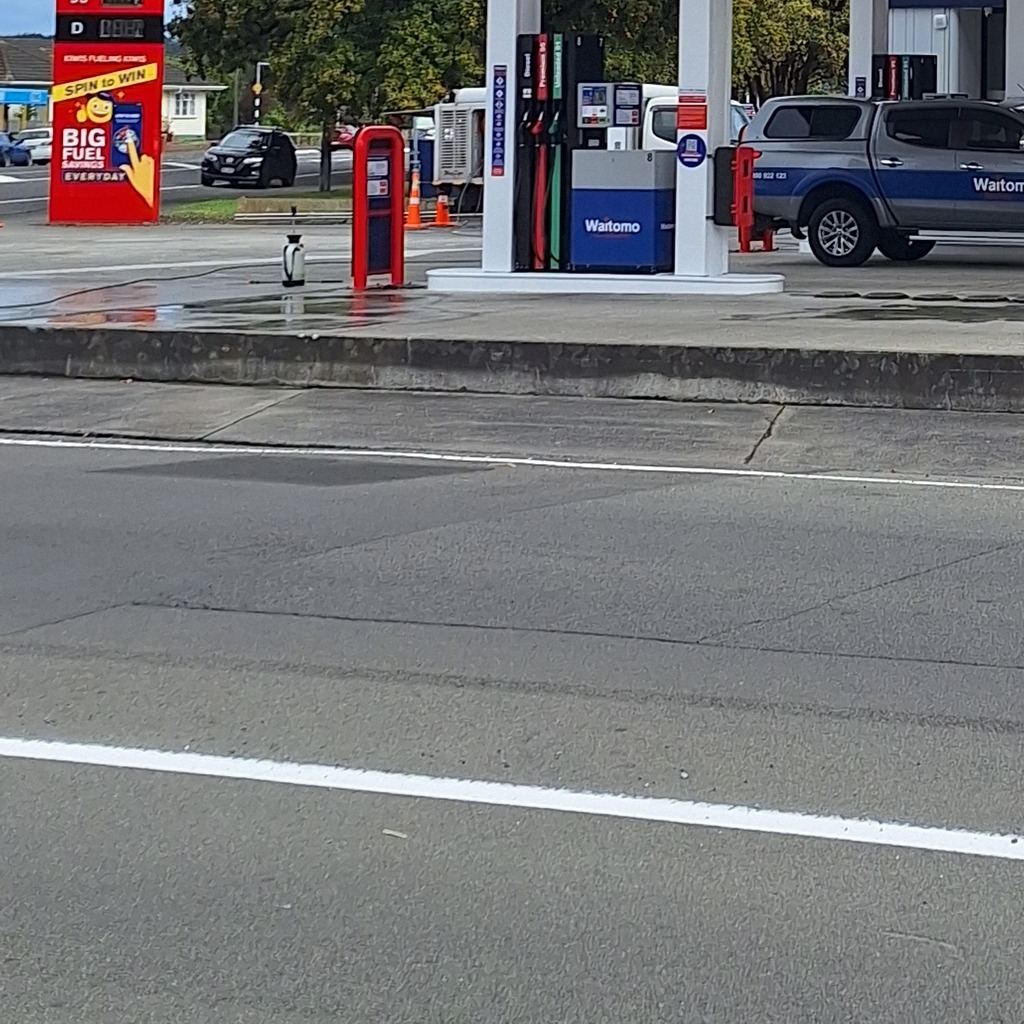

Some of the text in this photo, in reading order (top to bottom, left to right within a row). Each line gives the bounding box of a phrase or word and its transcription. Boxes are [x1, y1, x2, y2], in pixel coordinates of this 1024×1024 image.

[70, 21, 84, 35] D
[65, 69, 146, 97] SPIN to WIN
[62, 128, 106, 147] BIG
[62, 147, 105, 160] FUEL
[647, 152, 653, 162] 8
[64, 172, 126, 182] EVERYDAY
[584, 218, 641, 233] Waitomo
